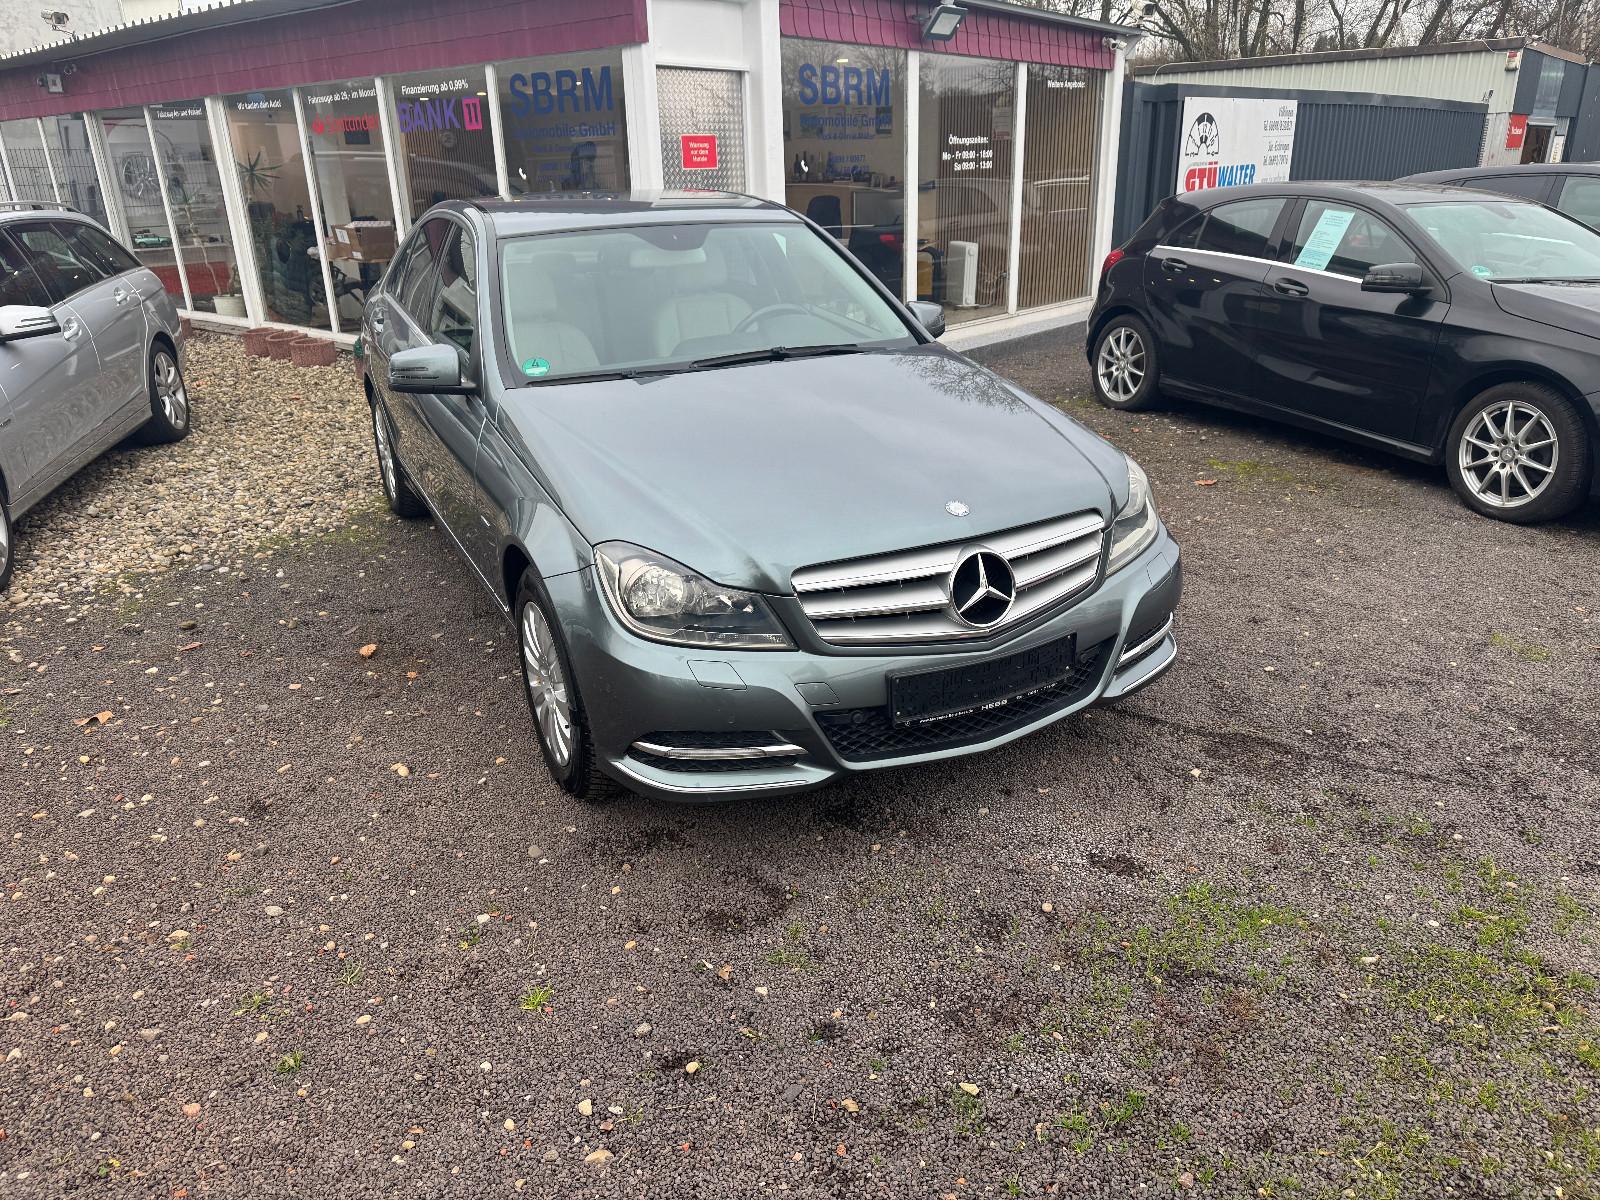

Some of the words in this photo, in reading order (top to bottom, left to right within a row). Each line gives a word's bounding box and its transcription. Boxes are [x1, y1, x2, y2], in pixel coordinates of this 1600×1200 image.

[401, 83, 439, 97] Finanzierung
[440, 81, 449, 91] ab
[799, 63, 890, 106] SBRM
[1047, 80, 1064, 88] Weitere
[509, 66, 615, 118] SBRM
[397, 97, 461, 133] BANK
[580, 122, 616, 137] GmbH
[949, 134, 989, 146] Öffnungszeiten:
[942, 151, 952, 160] Mo
[955, 150, 962, 159] Fr
[962, 150, 976, 159] 09:00
[954, 162, 962, 171] Sa
[962, 161, 976, 170] 09:00
[1185, 161, 1218, 192] GTÜ
[1217, 164, 1256, 187] WALTER
